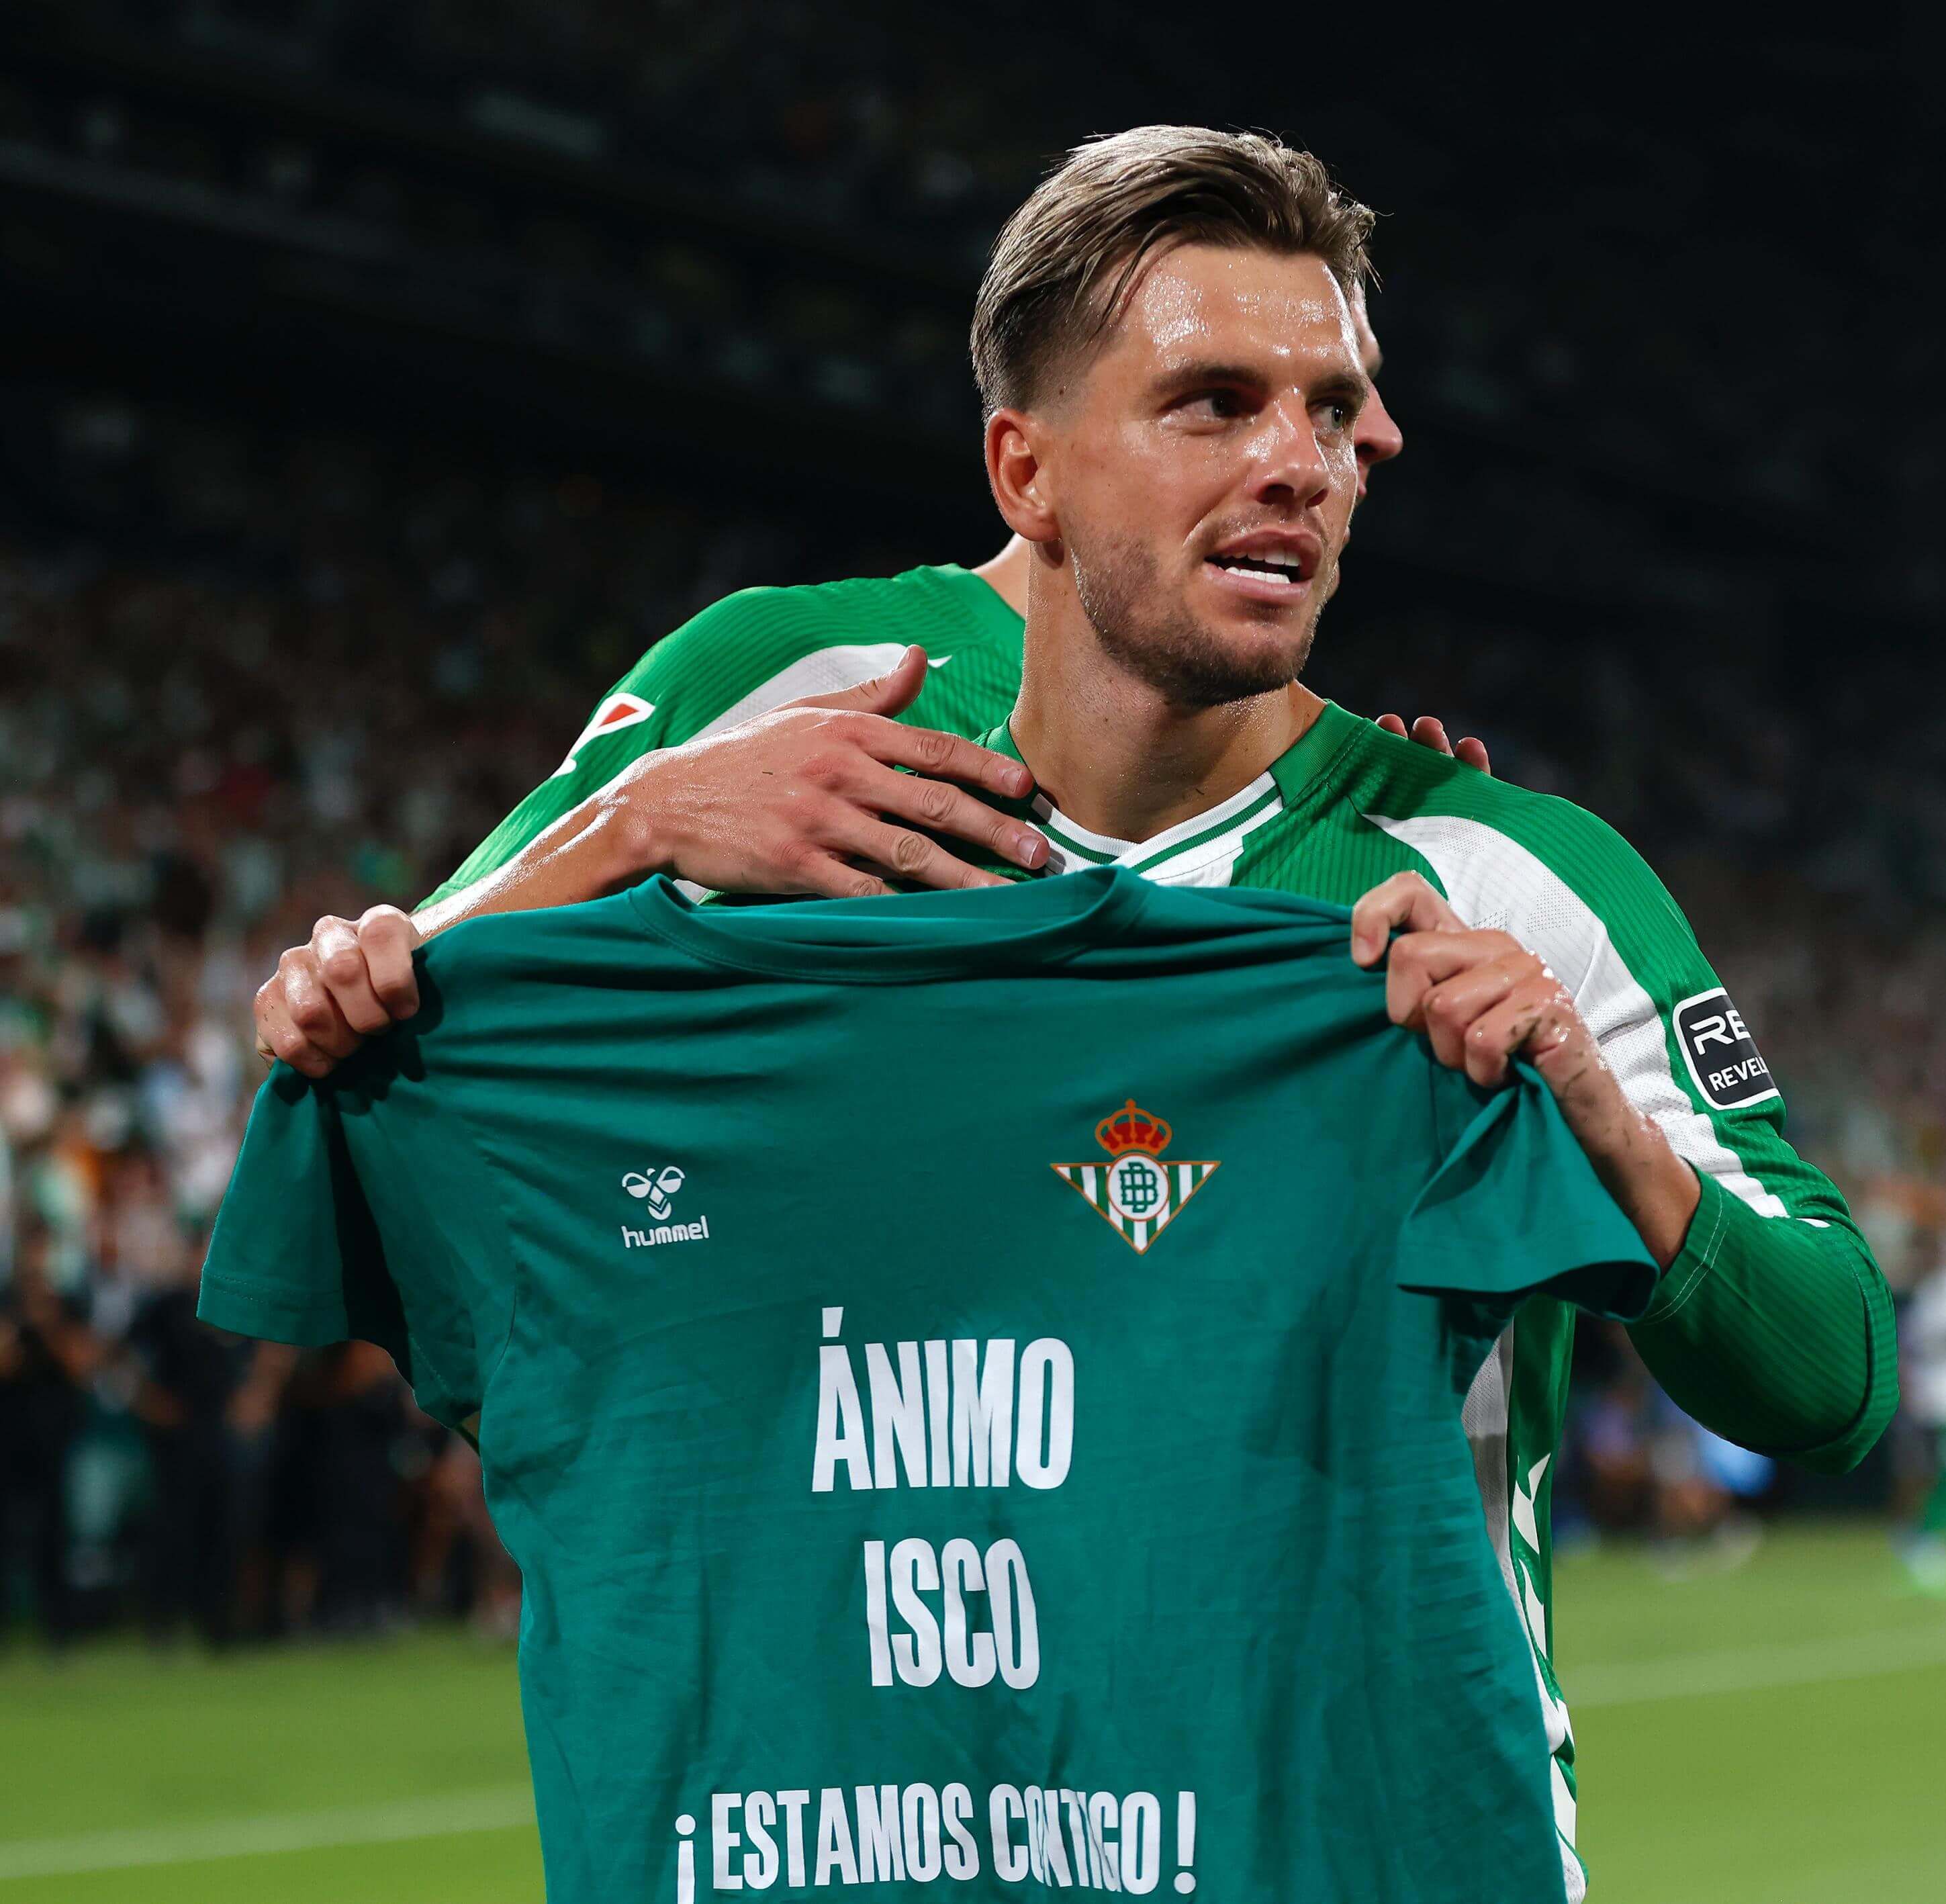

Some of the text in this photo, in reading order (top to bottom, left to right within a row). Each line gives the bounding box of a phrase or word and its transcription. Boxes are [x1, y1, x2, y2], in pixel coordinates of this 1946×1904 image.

[621, 1215, 709, 1248] hummel
[812, 1306, 1074, 1492] ÁNIMO
[864, 1538, 1040, 1690] ISCO
